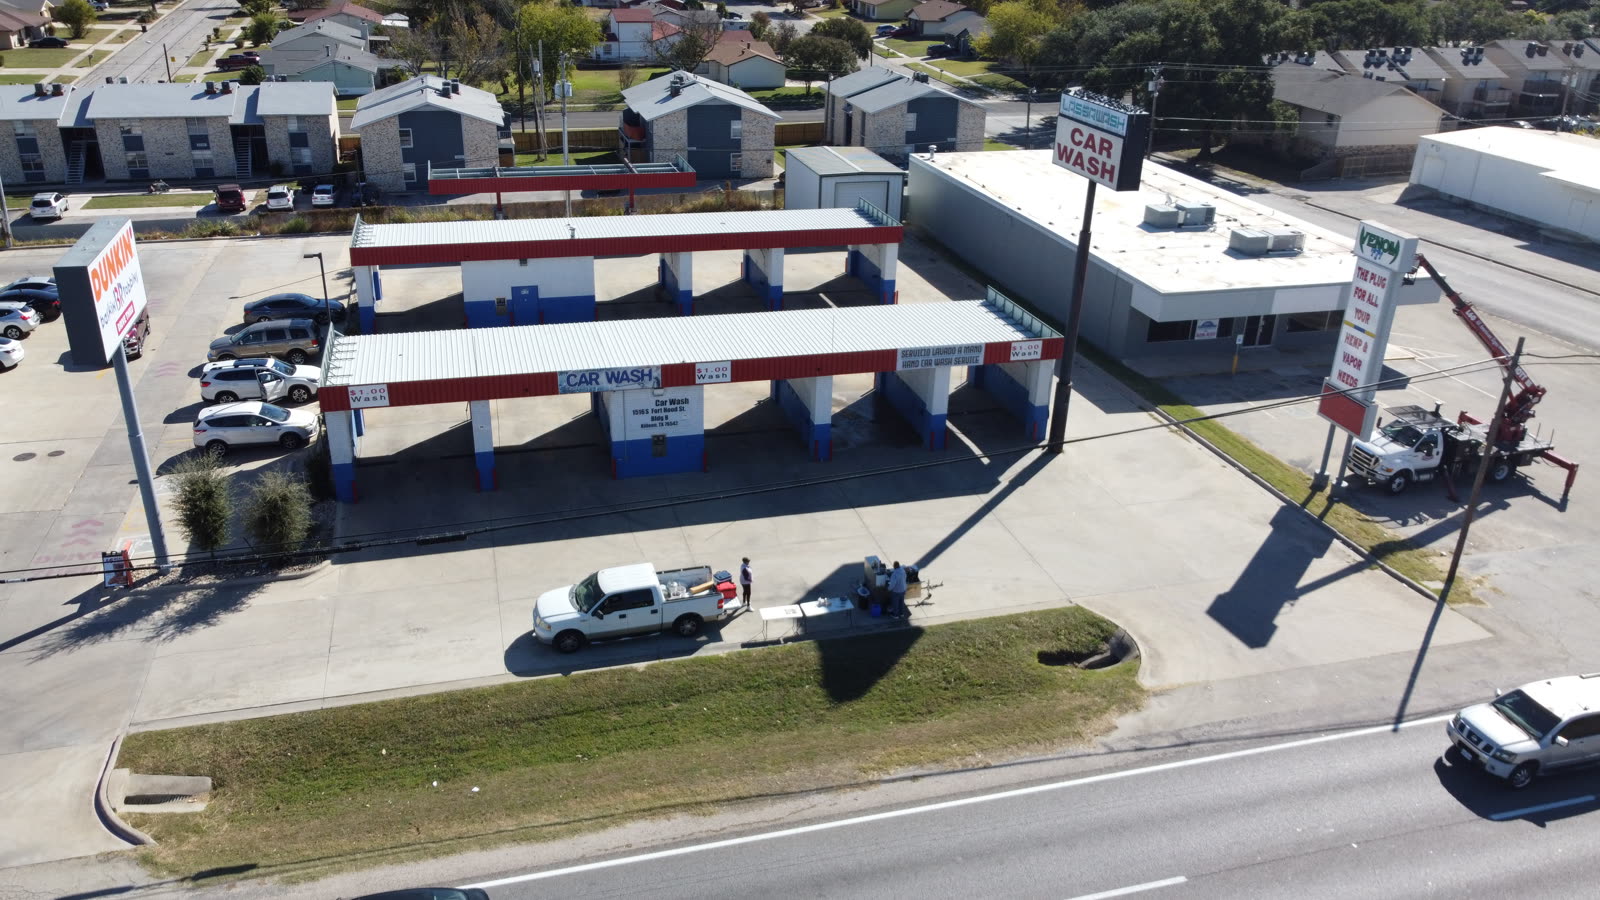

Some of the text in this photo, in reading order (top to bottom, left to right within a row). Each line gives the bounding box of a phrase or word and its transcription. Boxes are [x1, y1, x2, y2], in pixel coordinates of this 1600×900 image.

[1070, 127, 1113, 159] CAR
[1057, 143, 1116, 183] WASH
[1360, 226, 1400, 264] VENOM
[91, 226, 134, 302] DUNKIN'
[1357, 266, 1387, 289] THE PLUG
[1353, 286, 1379, 308] FOR ALL
[1354, 307, 1371, 325] YOUR
[901, 348, 931, 358] SERVICIO
[932, 346, 956, 357] LAVADO
[963, 345, 982, 354] MANO
[1344, 332, 1368, 353] HEMP &
[696, 366, 728, 374] $1.00
[902, 355, 980, 369] HAND CAR WASH SERVICE
[1342, 351, 1363, 371] VAPOR
[566, 368, 653, 388] CAR WASH
[1336, 369, 1359, 388] NEEDS
[350, 388, 386, 396] $1.00
[350, 395, 386, 403] Wash
[655, 397, 689, 407] Car Wash
